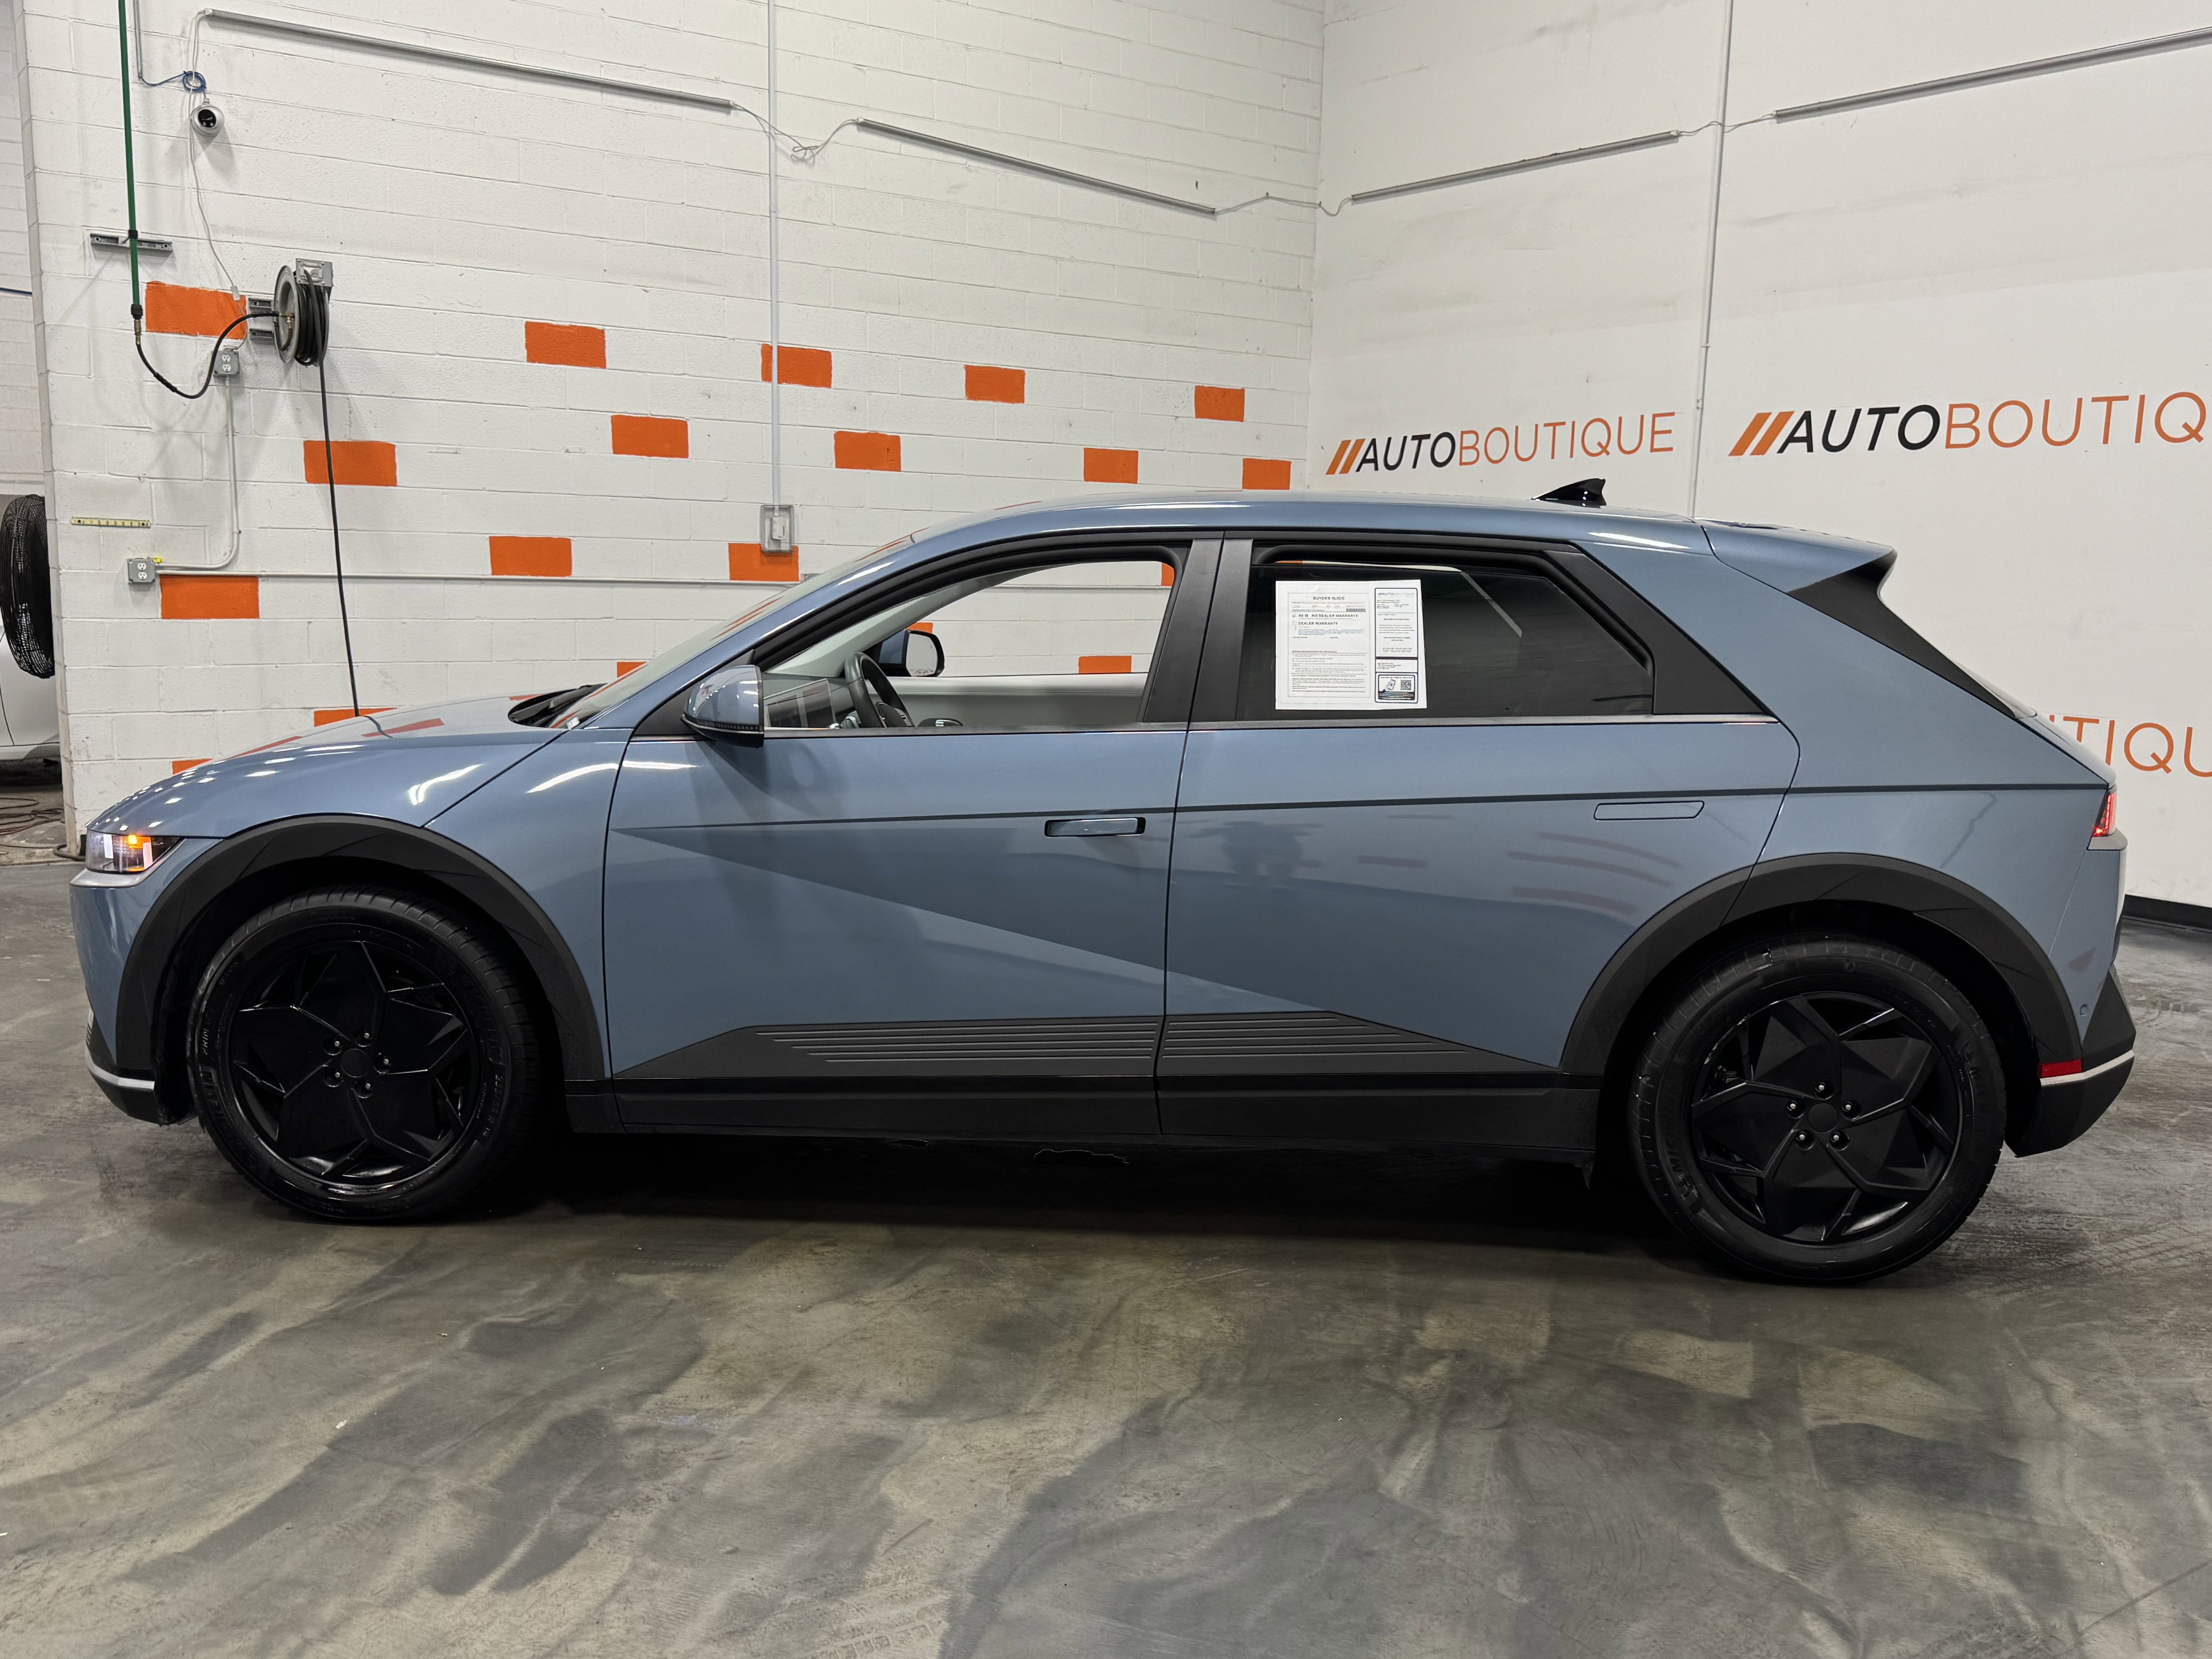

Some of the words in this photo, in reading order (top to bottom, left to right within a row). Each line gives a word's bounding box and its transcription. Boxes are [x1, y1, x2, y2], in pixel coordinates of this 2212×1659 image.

[1355, 412, 1676, 472] AUTOBOUTIQUE
[1777, 392, 2207, 453] AUTOBOUTIQ
[2049, 715, 2212, 778] TIQU
